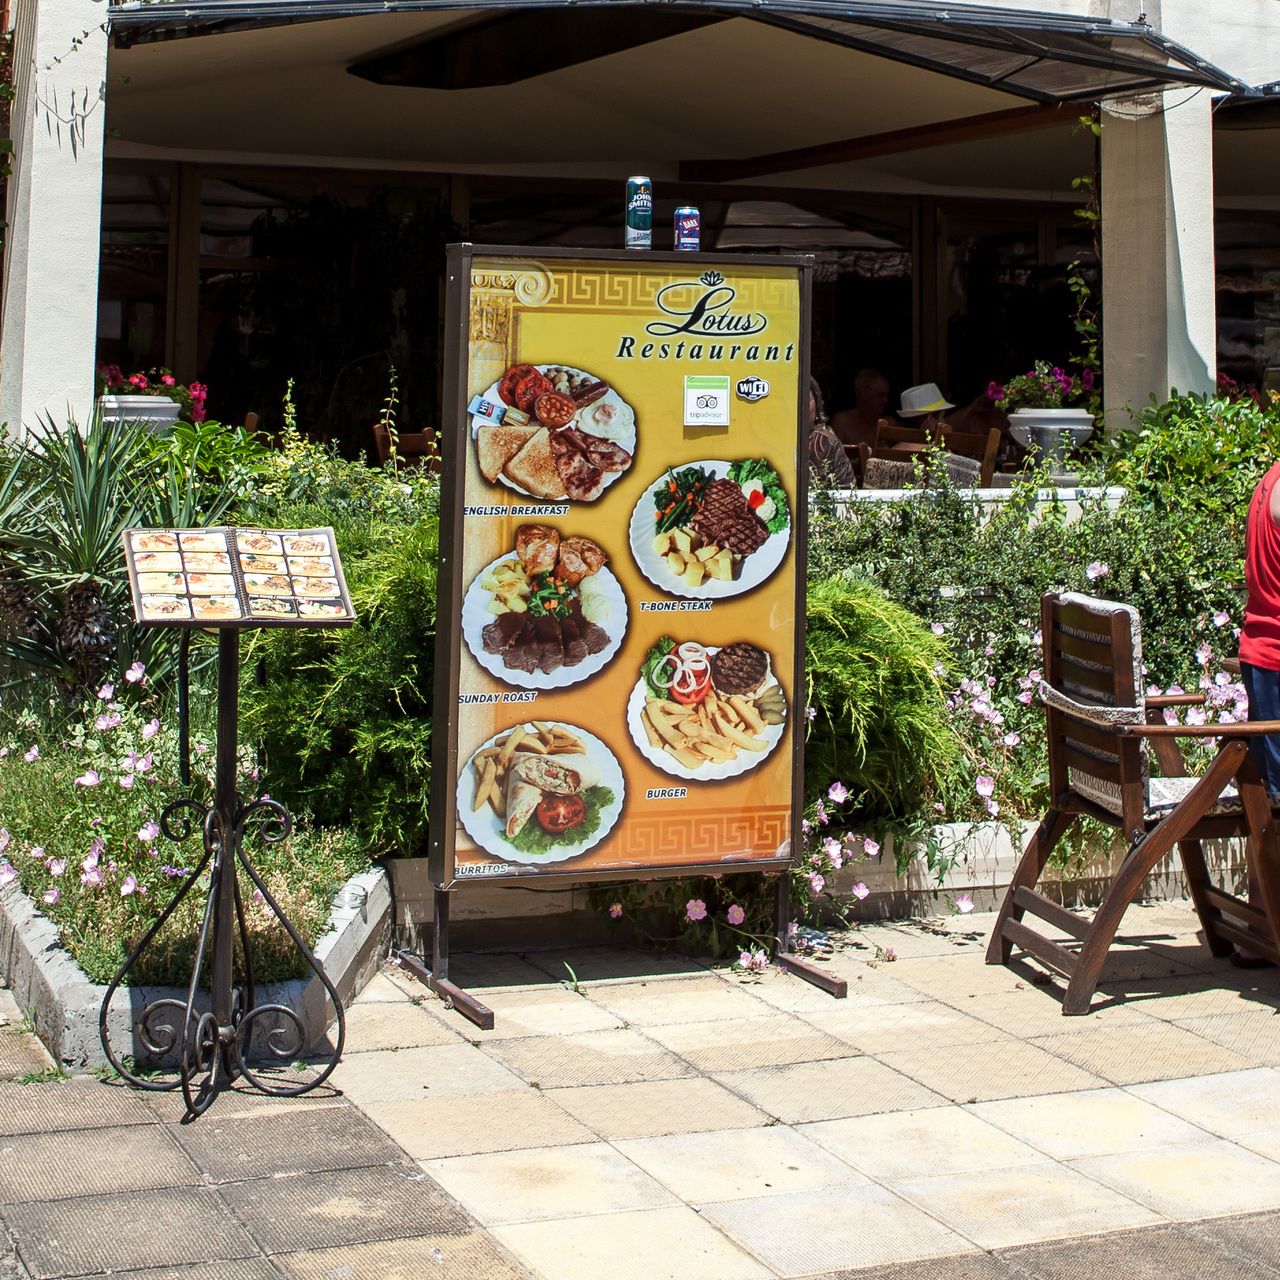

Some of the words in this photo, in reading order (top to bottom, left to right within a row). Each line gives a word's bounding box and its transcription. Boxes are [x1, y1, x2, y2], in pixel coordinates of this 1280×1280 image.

[646, 282, 767, 337] Lotus
[616, 336, 794, 361] Restaurant
[464, 505, 508, 516] ENGLISH
[511, 505, 569, 516] BREAKFAST
[640, 601, 677, 611] T-BONE
[680, 601, 712, 610] STEAK
[458, 693, 500, 704] SUNDAY
[503, 691, 537, 702] ROAST
[646, 788, 687, 799] BURGER
[455, 864, 508, 875] BURRITOS
